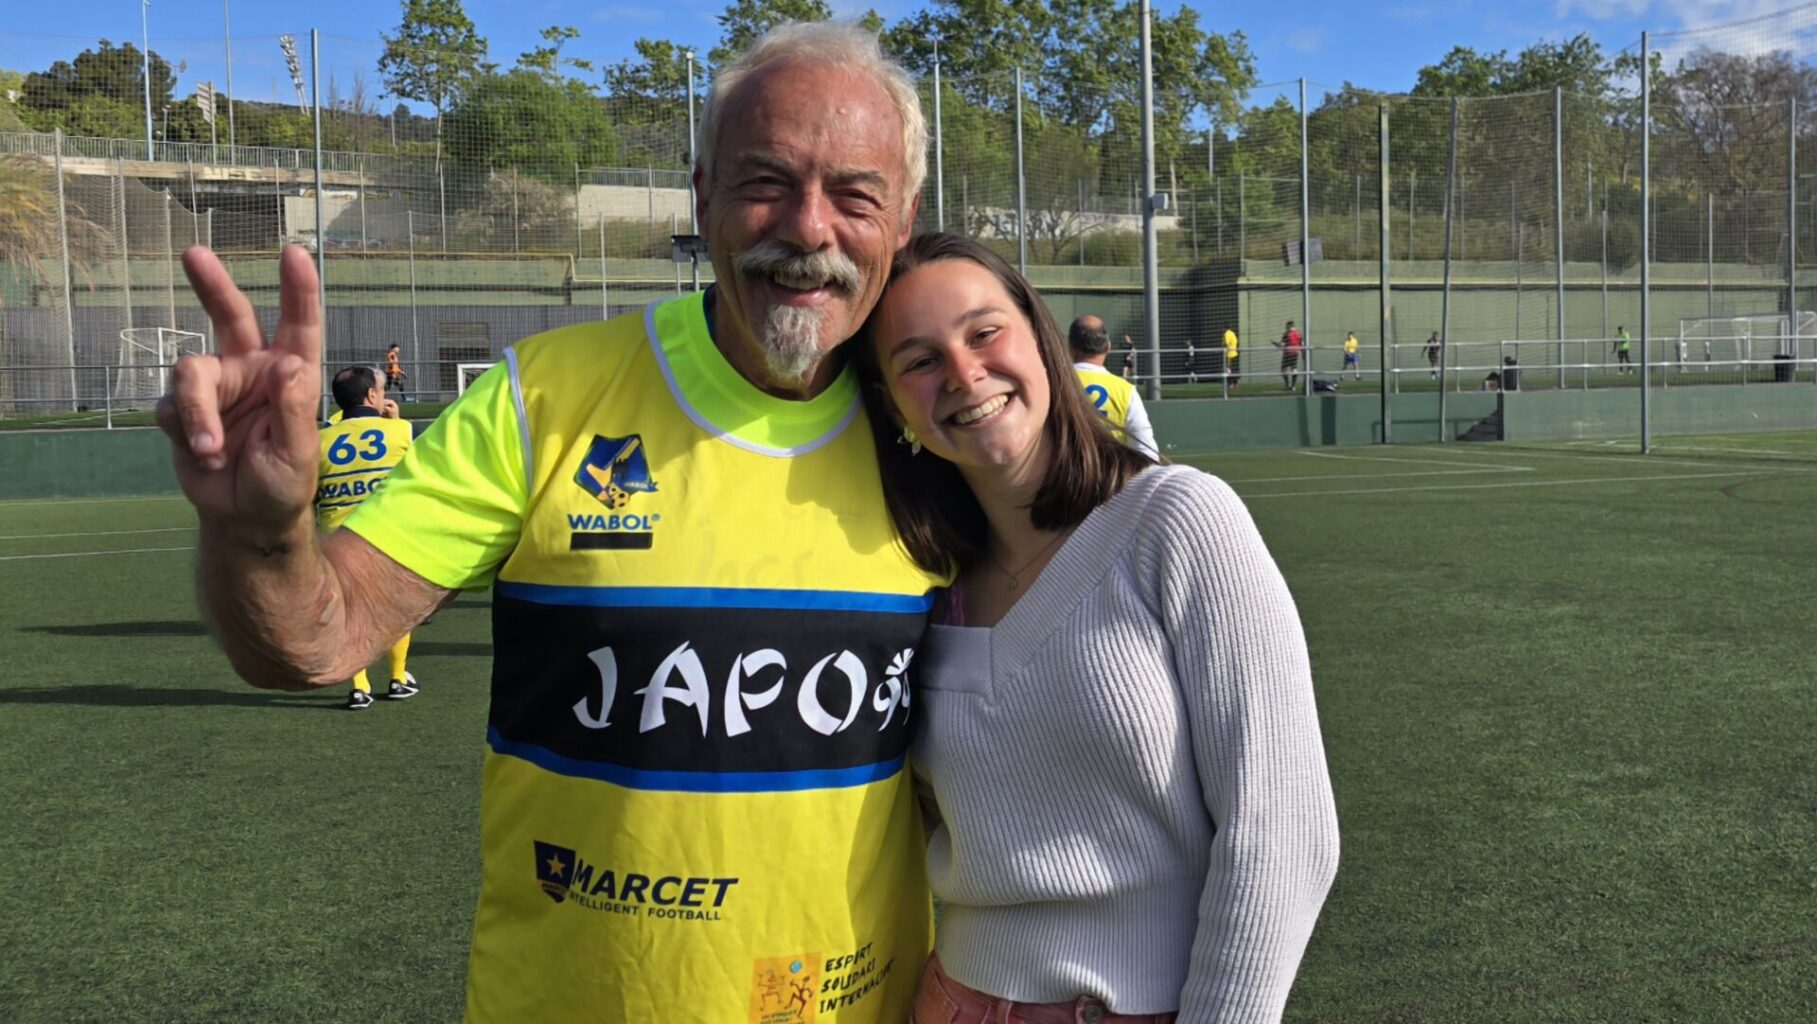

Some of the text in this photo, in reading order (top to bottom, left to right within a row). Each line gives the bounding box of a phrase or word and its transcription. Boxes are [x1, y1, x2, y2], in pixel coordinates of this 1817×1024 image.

[327, 429, 387, 465] 63
[571, 858, 739, 907] MARCET
[570, 892, 721, 921] TELLIGENT FOOTBALL
